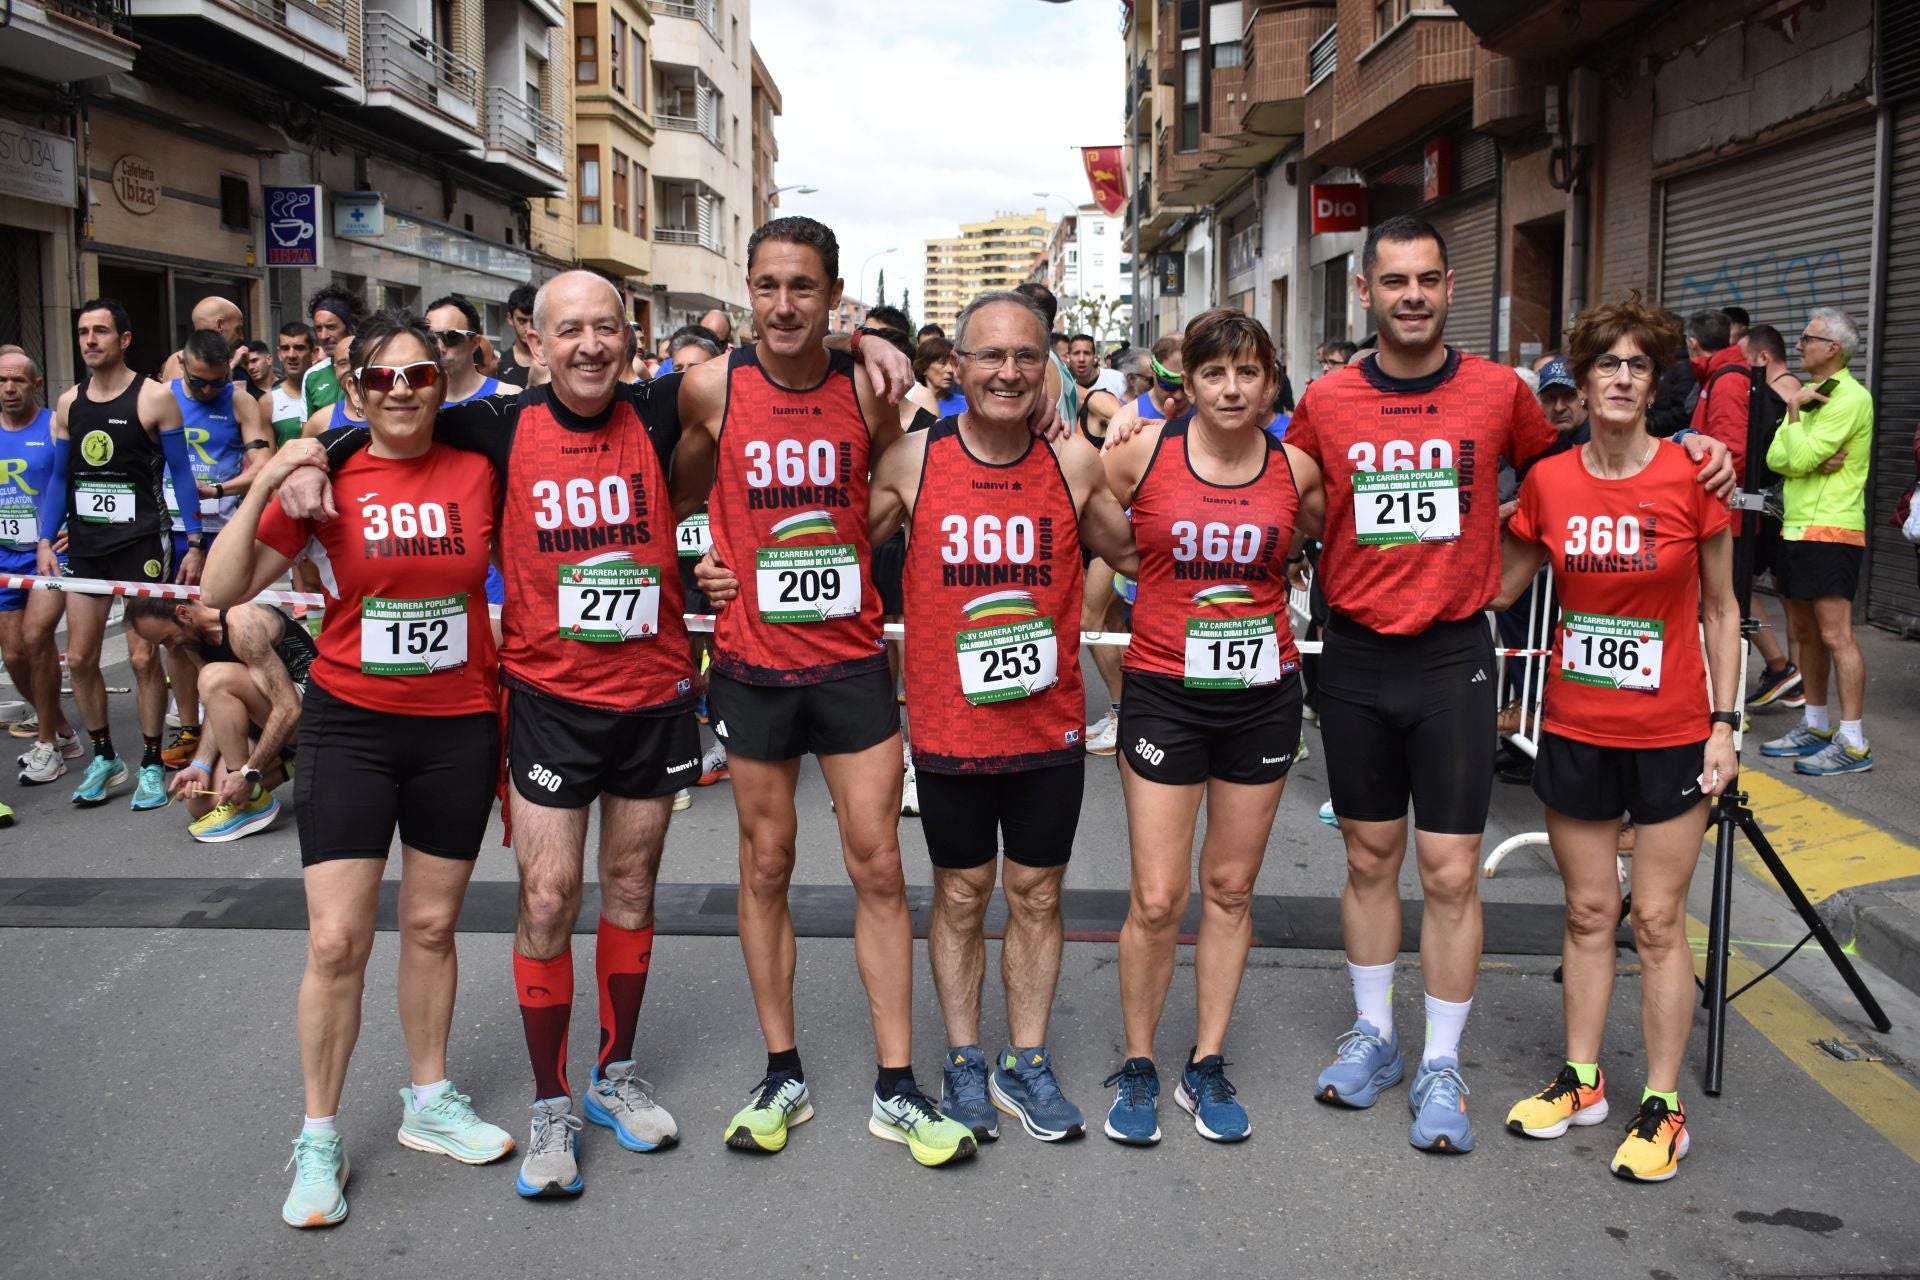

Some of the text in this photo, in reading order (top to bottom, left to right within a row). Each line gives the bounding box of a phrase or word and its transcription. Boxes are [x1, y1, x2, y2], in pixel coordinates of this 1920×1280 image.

[122, 176, 155, 206] Ibiza
[772, 406, 809, 415] luanvi
[1381, 405, 1422, 415] luanvi
[561, 444, 597, 454] luanvi
[744, 439, 835, 488] 360
[839, 442, 851, 483] RIOJA
[1458, 440, 1475, 487] RIOJA
[972, 480, 1008, 489] luanvi
[1357, 482, 1389, 491] CALAHORRA
[1390, 481, 1411, 490] CIUDAD
[1419, 480, 1427, 488] LA
[1427, 480, 1454, 488] VERDURA
[1376, 474, 1409, 482] CARRERA
[1411, 471, 1444, 480] POPULAR
[92, 494, 116, 512] 26
[532, 475, 630, 529] 360
[630, 472, 647, 518] RIOJA
[747, 486, 851, 510] RUNNERS
[1203, 496, 1236, 505] luanvi
[447, 502, 463, 534] RIOJA
[1375, 491, 1437, 525] 215
[1, 519, 20, 535] 13
[362, 502, 447, 540] 360
[537, 521, 651, 552] RUNNERS
[681, 527, 701, 546] 41
[941, 514, 1034, 564] 360
[1039, 517, 1052, 560] RIOJA
[1171, 520, 1261, 563] 360
[1261, 526, 1279, 563] RIOJA
[1565, 515, 1640, 555] 360
[1643, 517, 1657, 550] RIOJA
[365, 536, 465, 560] RUNNERS
[780, 550, 813, 558] CARRERA
[815, 547, 847, 556] POPULAR
[619, 568, 649, 576] POPULAR
[794, 559, 815, 567] CIUDAD
[1174, 562, 1268, 581] RUNNERS
[1565, 553, 1658, 573] RUNNERS
[597, 577, 618, 585] CIUDAD
[778, 568, 841, 603] 209
[943, 564, 1052, 586] RUNNERS
[366, 610, 401, 618] CALAHORRA
[402, 610, 424, 618] CIUDAD
[441, 605, 464, 615] VERDURA
[375, 598, 456, 609] XV CARRERA POPULAR
[580, 588, 641, 621] 277
[967, 621, 1044, 640] XV CARRERA POPULAR
[1190, 629, 1222, 637] CALAHORRA
[1210, 621, 1242, 629] CARRERA
[1242, 618, 1268, 627] POPULAR
[1566, 622, 1594, 632] CALAHORRA
[1595, 626, 1615, 634] CIUDAD
[1616, 627, 1623, 635] DE
[1624, 628, 1632, 636] LA
[1583, 616, 1615, 626] CARRERA
[1617, 619, 1650, 629] POPULAR
[385, 619, 449, 655] 152
[960, 629, 1052, 651] CALAHORRA CIUDAD DE LA VERDURA
[979, 643, 1041, 683] 253
[1208, 638, 1263, 671] 157
[1581, 635, 1639, 671] 186
[1135, 737, 1165, 766] 360
[1262, 755, 1286, 764] luanvi
[527, 763, 563, 793] 360
[666, 759, 693, 775] luanvi
